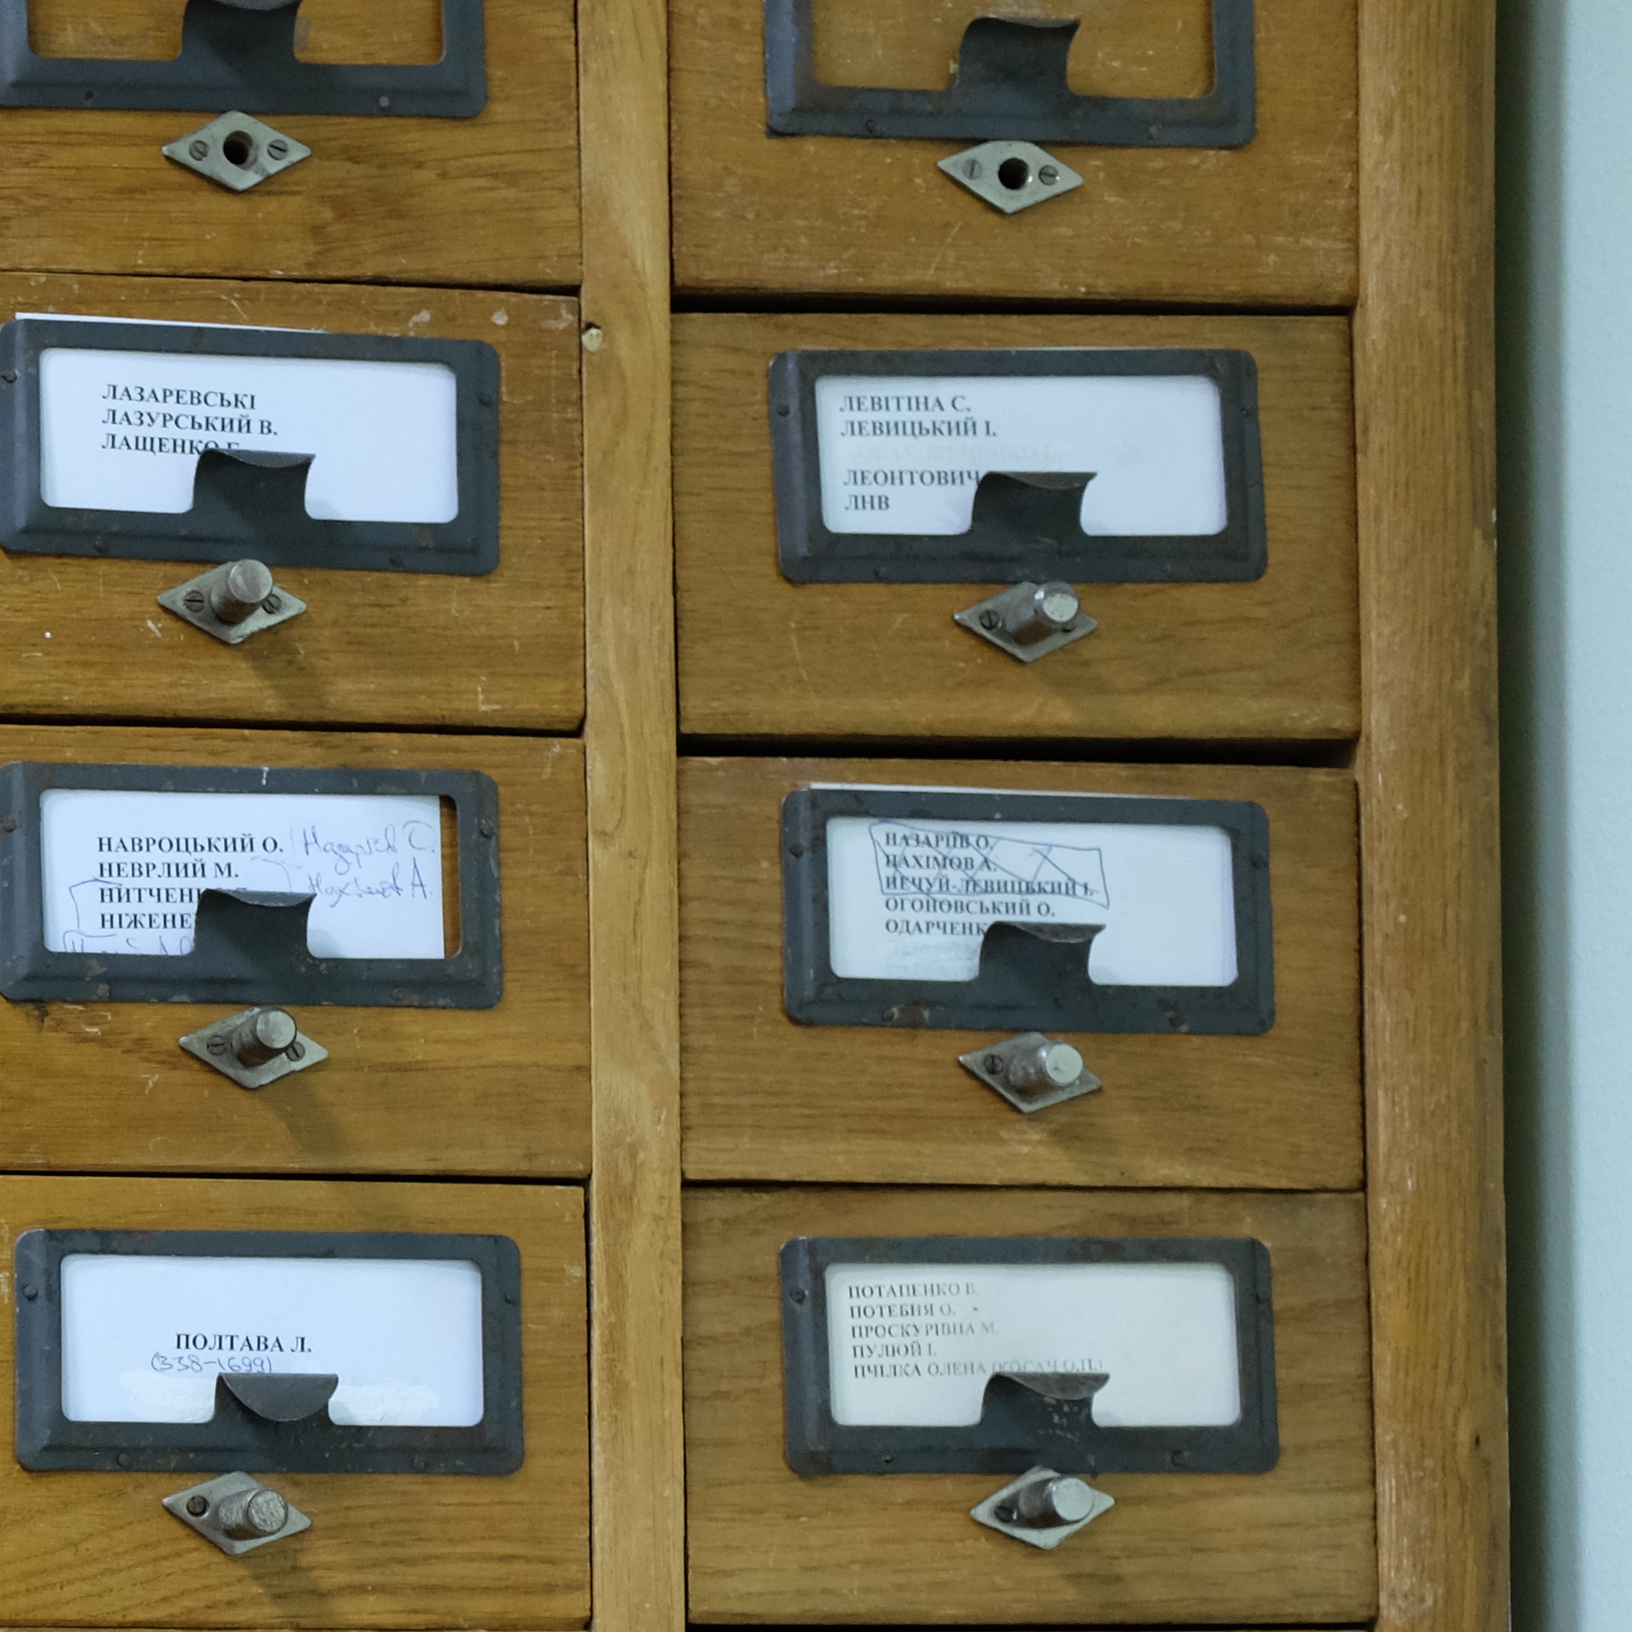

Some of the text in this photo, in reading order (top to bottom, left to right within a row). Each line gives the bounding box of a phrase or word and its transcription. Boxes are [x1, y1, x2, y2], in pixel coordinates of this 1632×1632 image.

[101, 384, 256, 410] ЛАЗАРЕВСЬКІ
[839, 395, 972, 413] ЛЕВІТІНА С.
[101, 408, 278, 436] ЛАЗУРСЬКИЙ В.
[840, 416, 997, 439] ЛЕВИЦЬКИЙ І.
[844, 494, 890, 511] ЛНВ
[98, 836, 284, 856] НАВРОЦЬКИЙ О.
[99, 862, 239, 879] НЕВРЛИЙ М.
[886, 898, 1055, 917] ОГОНОВСЬКИЙ О.
[848, 1283, 960, 1299] ПОТАПЕНКО
[850, 1304, 934, 1319] ПОТЕБНЯ
[176, 1333, 312, 1353] ПОЛТАВА Л.
[852, 1340, 922, 1359] ПУЛЮЙ
[853, 1364, 922, 1379] ПЧІЛКА
